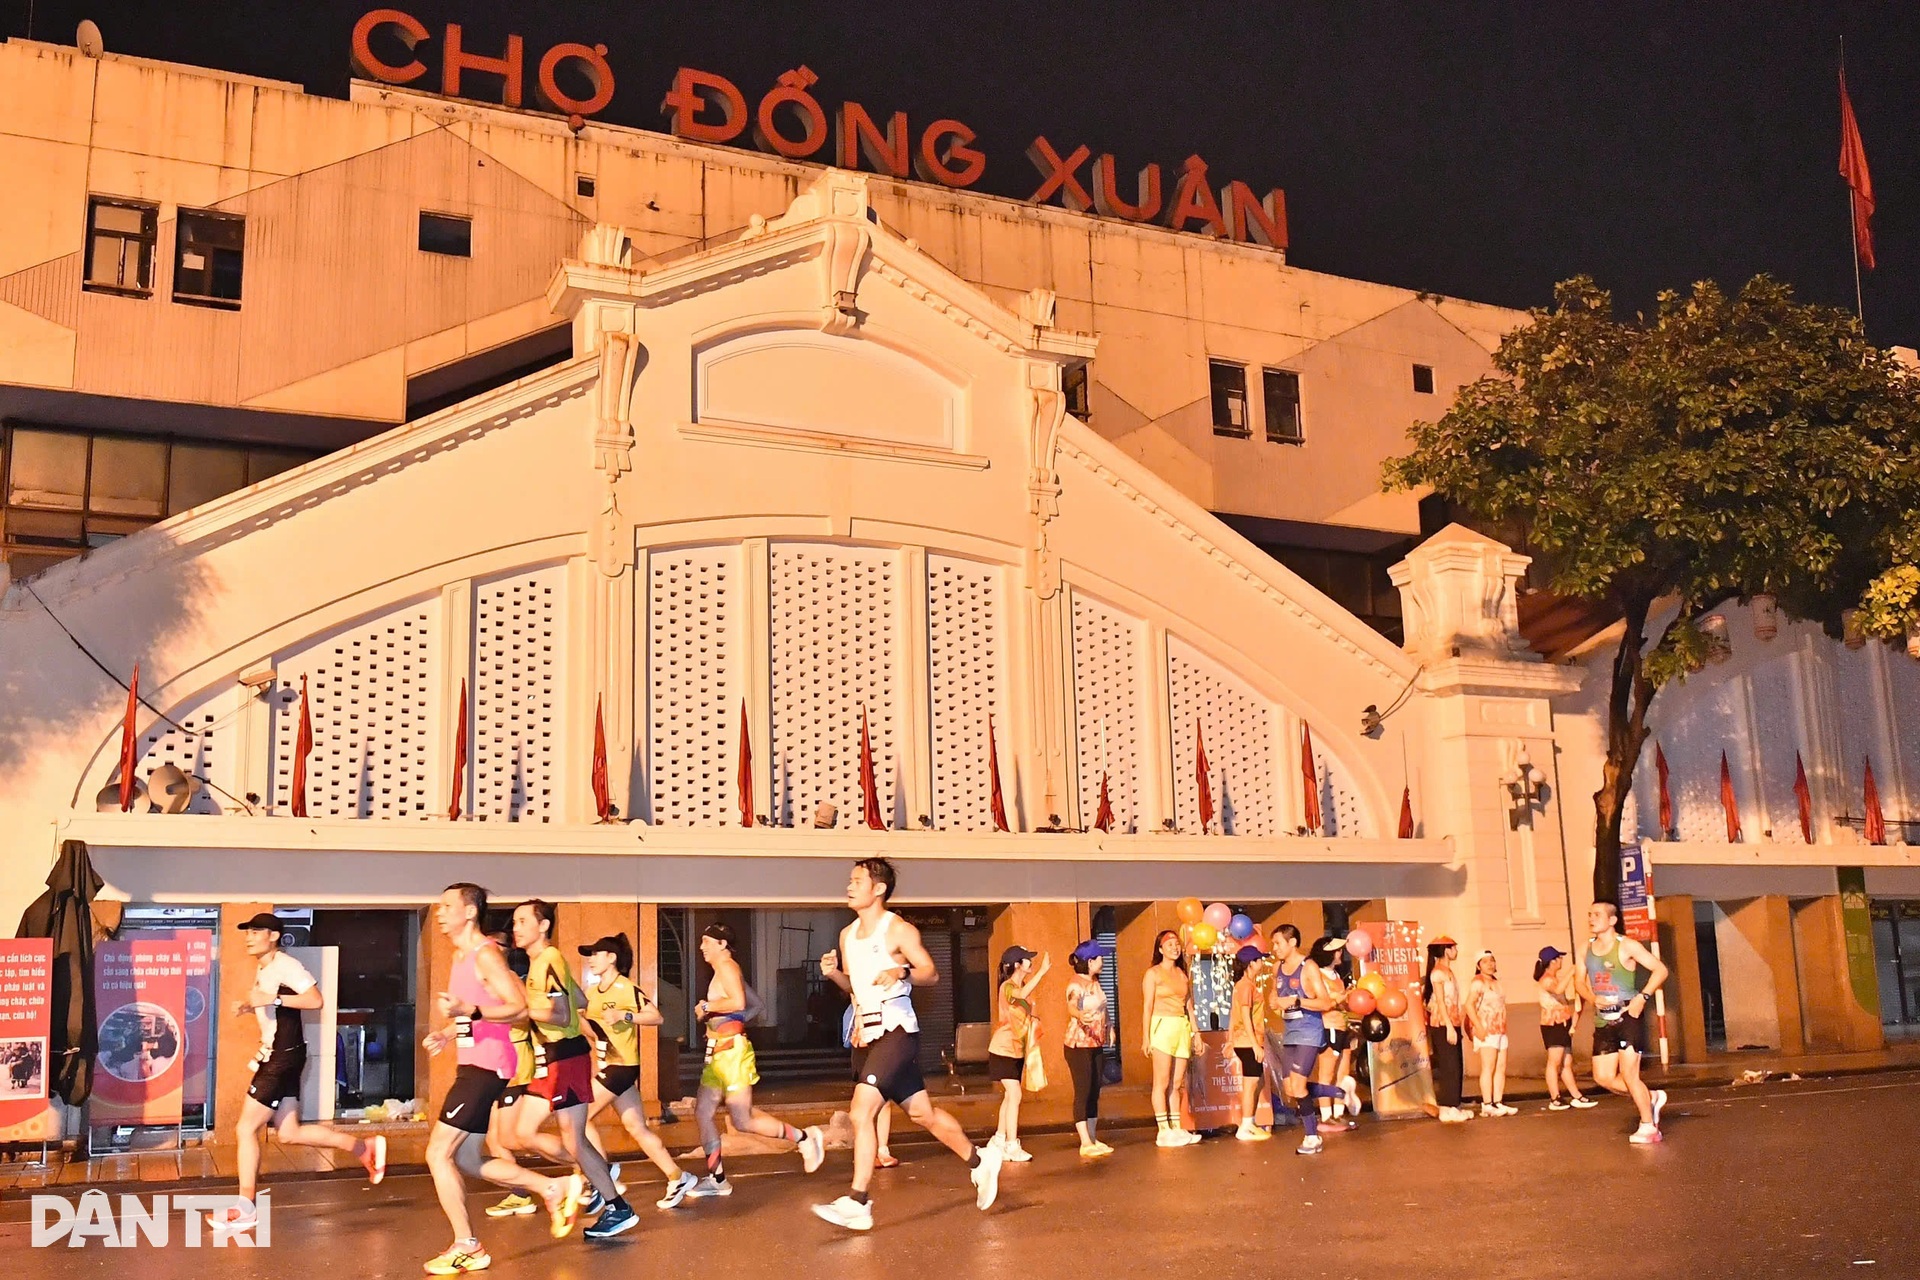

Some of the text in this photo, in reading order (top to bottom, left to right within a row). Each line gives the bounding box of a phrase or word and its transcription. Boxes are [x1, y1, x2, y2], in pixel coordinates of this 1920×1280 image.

[351, 8, 1288, 249] CHỢ ĐỒNG XUÂN
[1621, 857, 1636, 881] P
[1387, 948, 1419, 962] VESTA
[1380, 964, 1408, 975] RUNNER
[1212, 1076, 1243, 1085] THE VES
